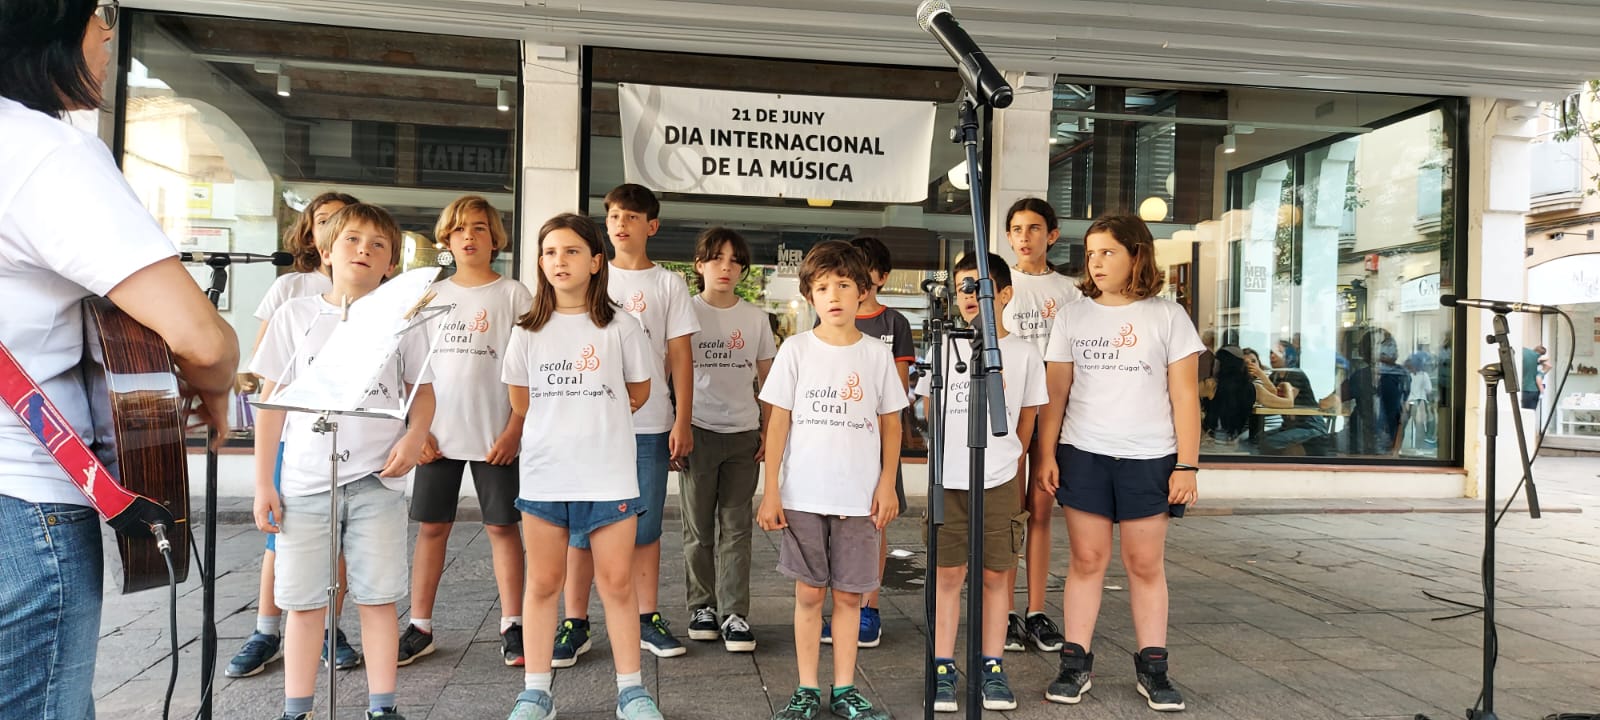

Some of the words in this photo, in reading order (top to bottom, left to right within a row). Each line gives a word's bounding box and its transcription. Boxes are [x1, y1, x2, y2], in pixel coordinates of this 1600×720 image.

[732, 108, 750, 121] 21
[756, 109, 778, 123] DE
[782, 110, 825, 125] JUNY
[665, 125, 704, 146] DIA
[710, 128, 885, 156] INTERNACIONAL
[702, 156, 731, 176] DE
[737, 157, 763, 178] LA
[770, 156, 853, 183] MÚSICA
[777, 249, 803, 262] MER
[1013, 308, 1039, 320] escola
[1020, 319, 1048, 331] Coral
[444, 332, 473, 344] Coral
[698, 338, 725, 349] escola
[1075, 337, 1110, 348] escola
[704, 349, 732, 359] Coral
[1083, 349, 1120, 360] Coral
[539, 359, 573, 372] escola
[547, 373, 583, 385] Coral
[950, 380, 970, 392] esco
[566, 389, 581, 397] Sant
[805, 386, 838, 399] escola
[812, 400, 848, 415] Coral
